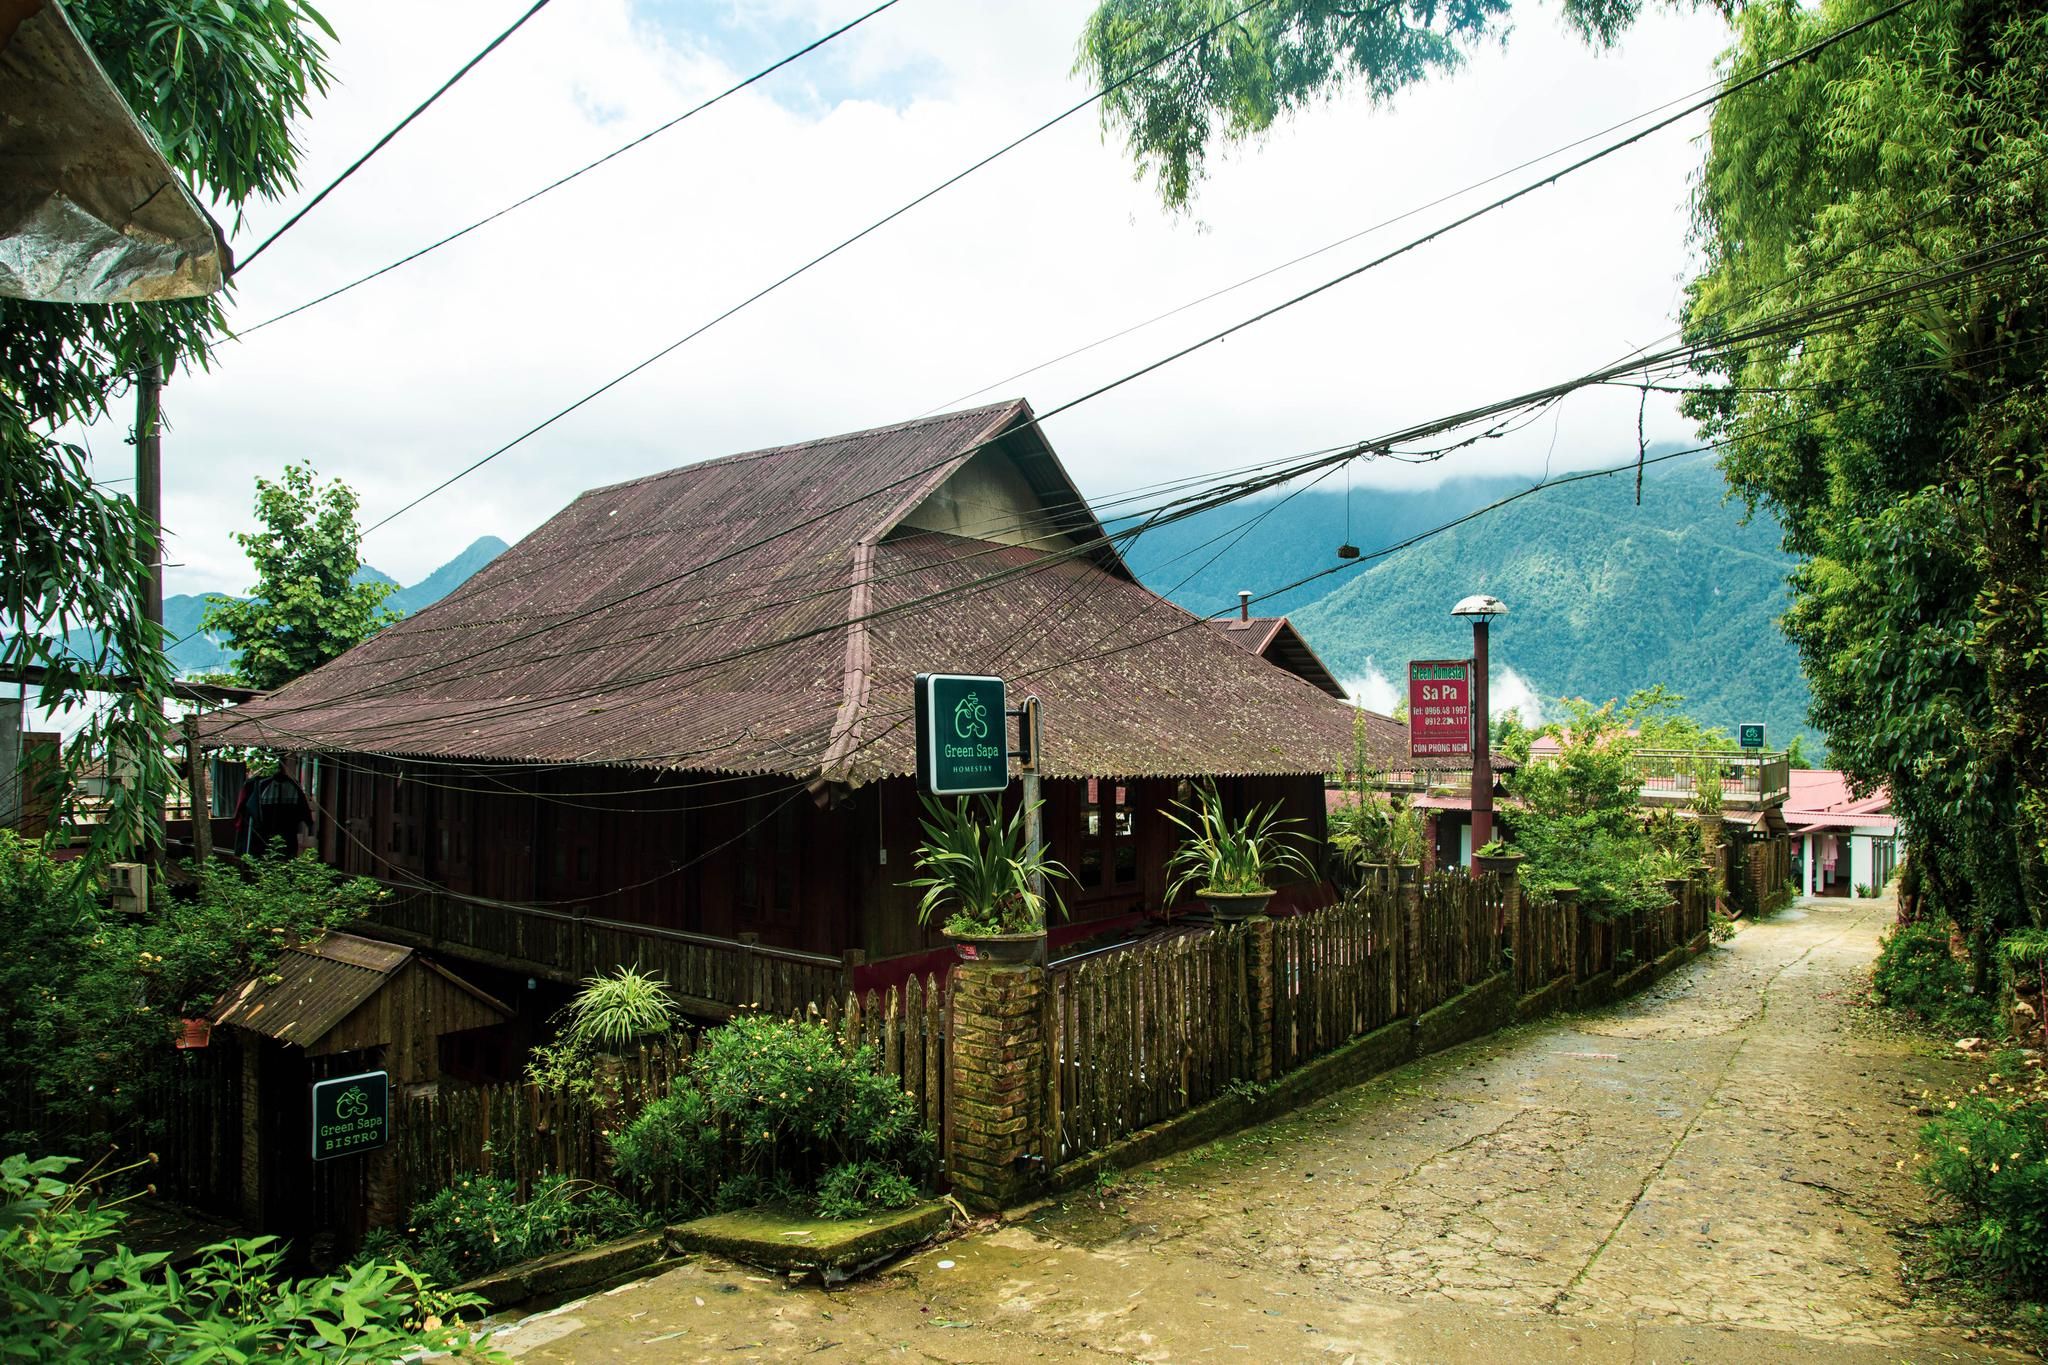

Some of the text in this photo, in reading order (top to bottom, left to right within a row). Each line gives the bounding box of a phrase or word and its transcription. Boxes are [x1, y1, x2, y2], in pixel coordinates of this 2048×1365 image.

[1412, 664, 1466, 681] Green Homestay
[1422, 685, 1457, 700] Sa Pa
[945, 744, 999, 758] Green Sapa
[953, 765, 992, 773] HOMESTAY
[321, 1116, 383, 1137] Green Sapa
[325, 1131, 378, 1150] BISTRO
